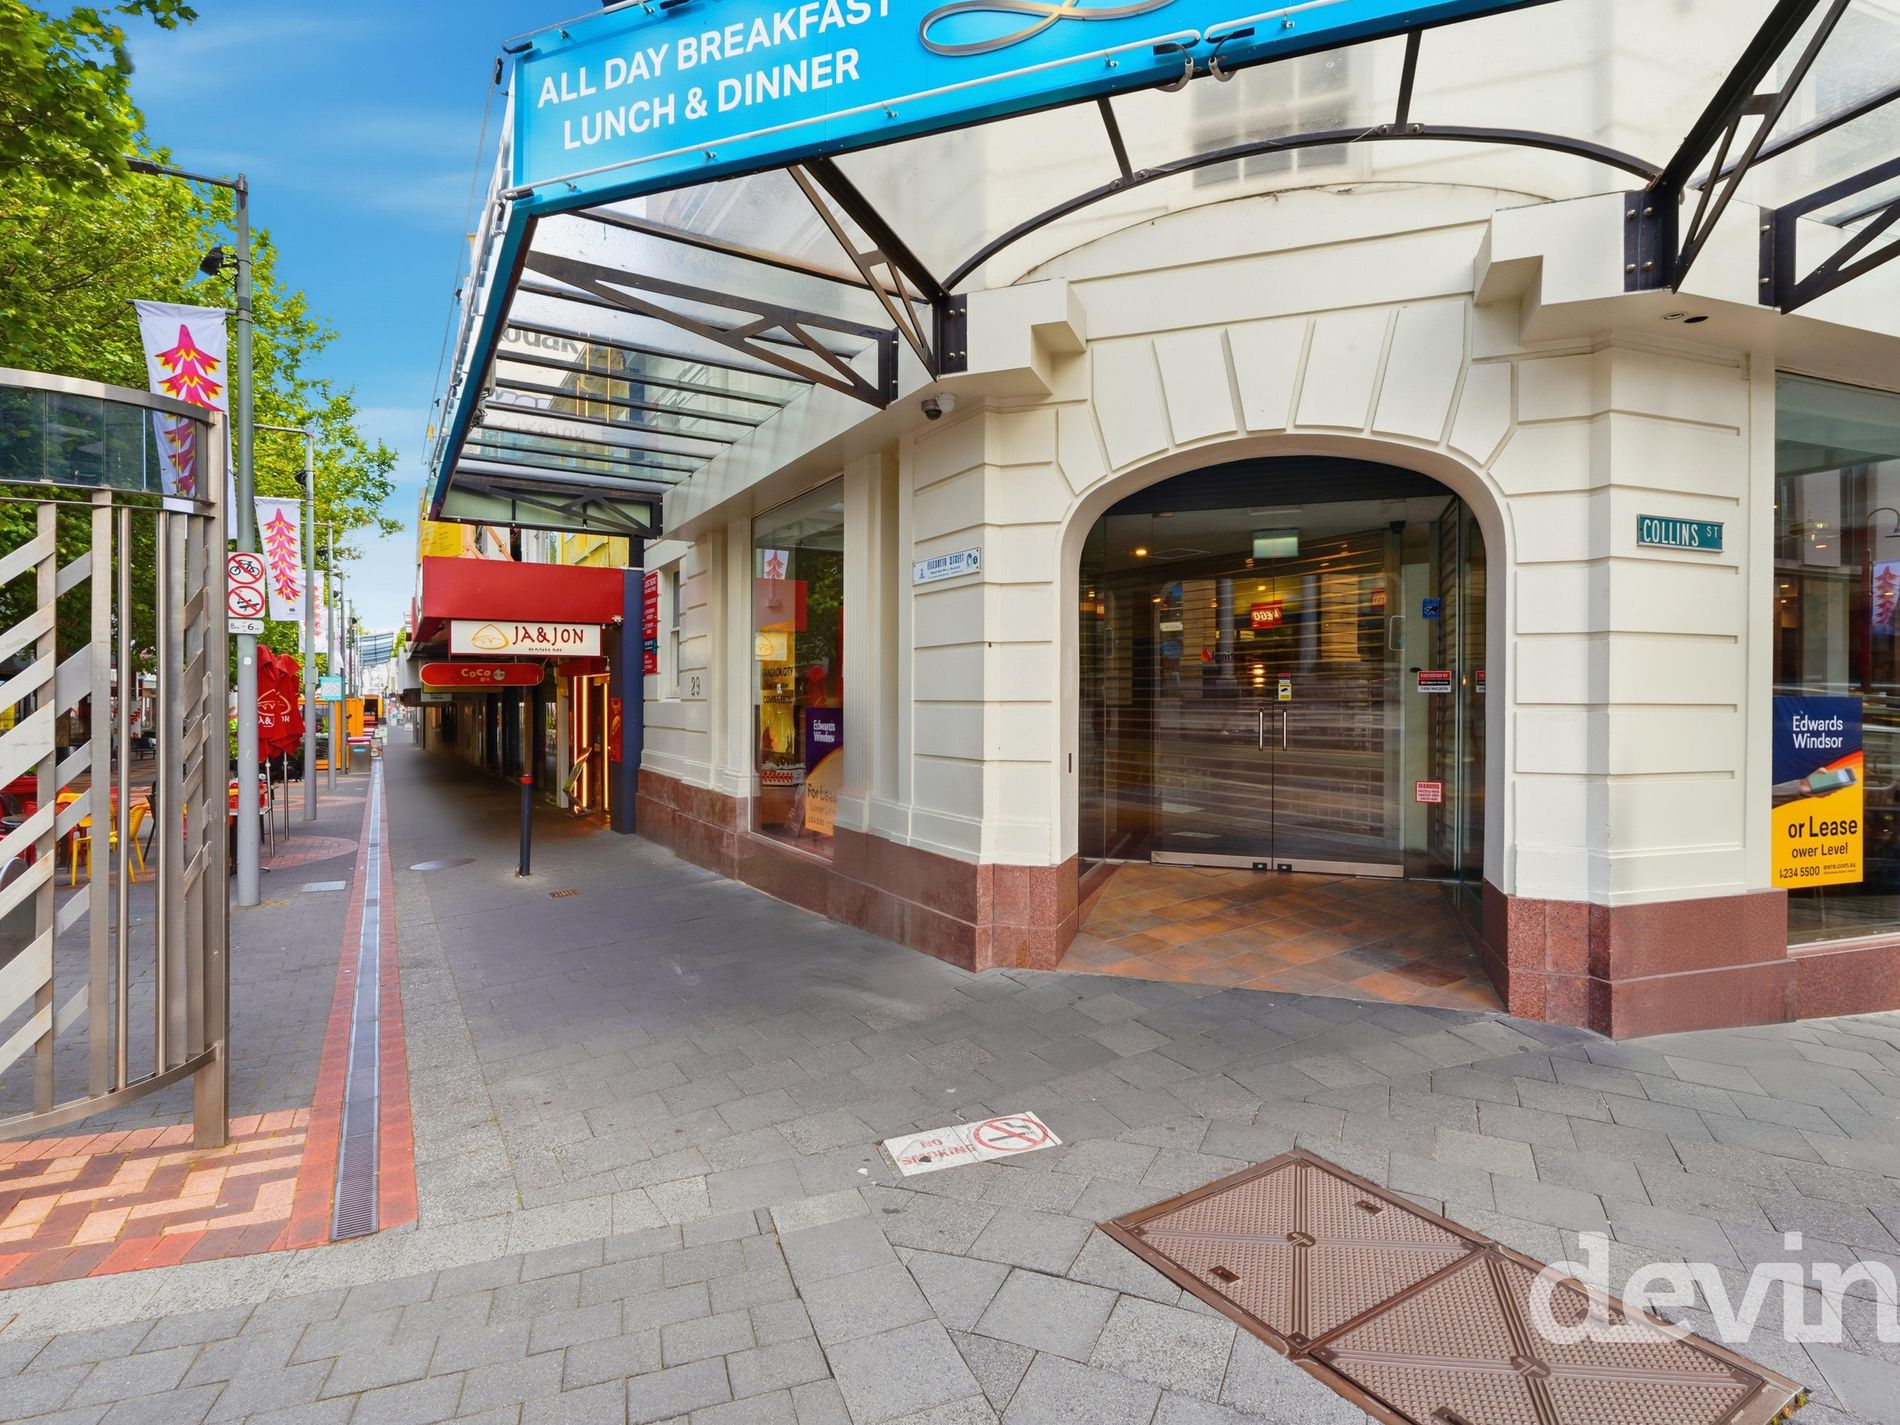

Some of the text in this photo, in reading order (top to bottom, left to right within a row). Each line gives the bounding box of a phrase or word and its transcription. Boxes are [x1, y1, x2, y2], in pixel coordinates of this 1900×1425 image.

[538, 0, 889, 108] ALL DAY BREAKFAST
[564, 48, 860, 150] LUNCH & DINNER
[1643, 519, 1718, 546] COLLINS ST
[512, 625, 584, 646] JA&JON
[690, 676, 701, 697] 29
[1792, 715, 1844, 731] Edwards
[1792, 732, 1843, 749] Windsor
[1809, 816, 1858, 837] Lease
[1821, 842, 1848, 856] Level
[1800, 866, 1820, 877] 5500
[920, 1138, 944, 1148] NO
[900, 1144, 976, 1166] SMOKING
